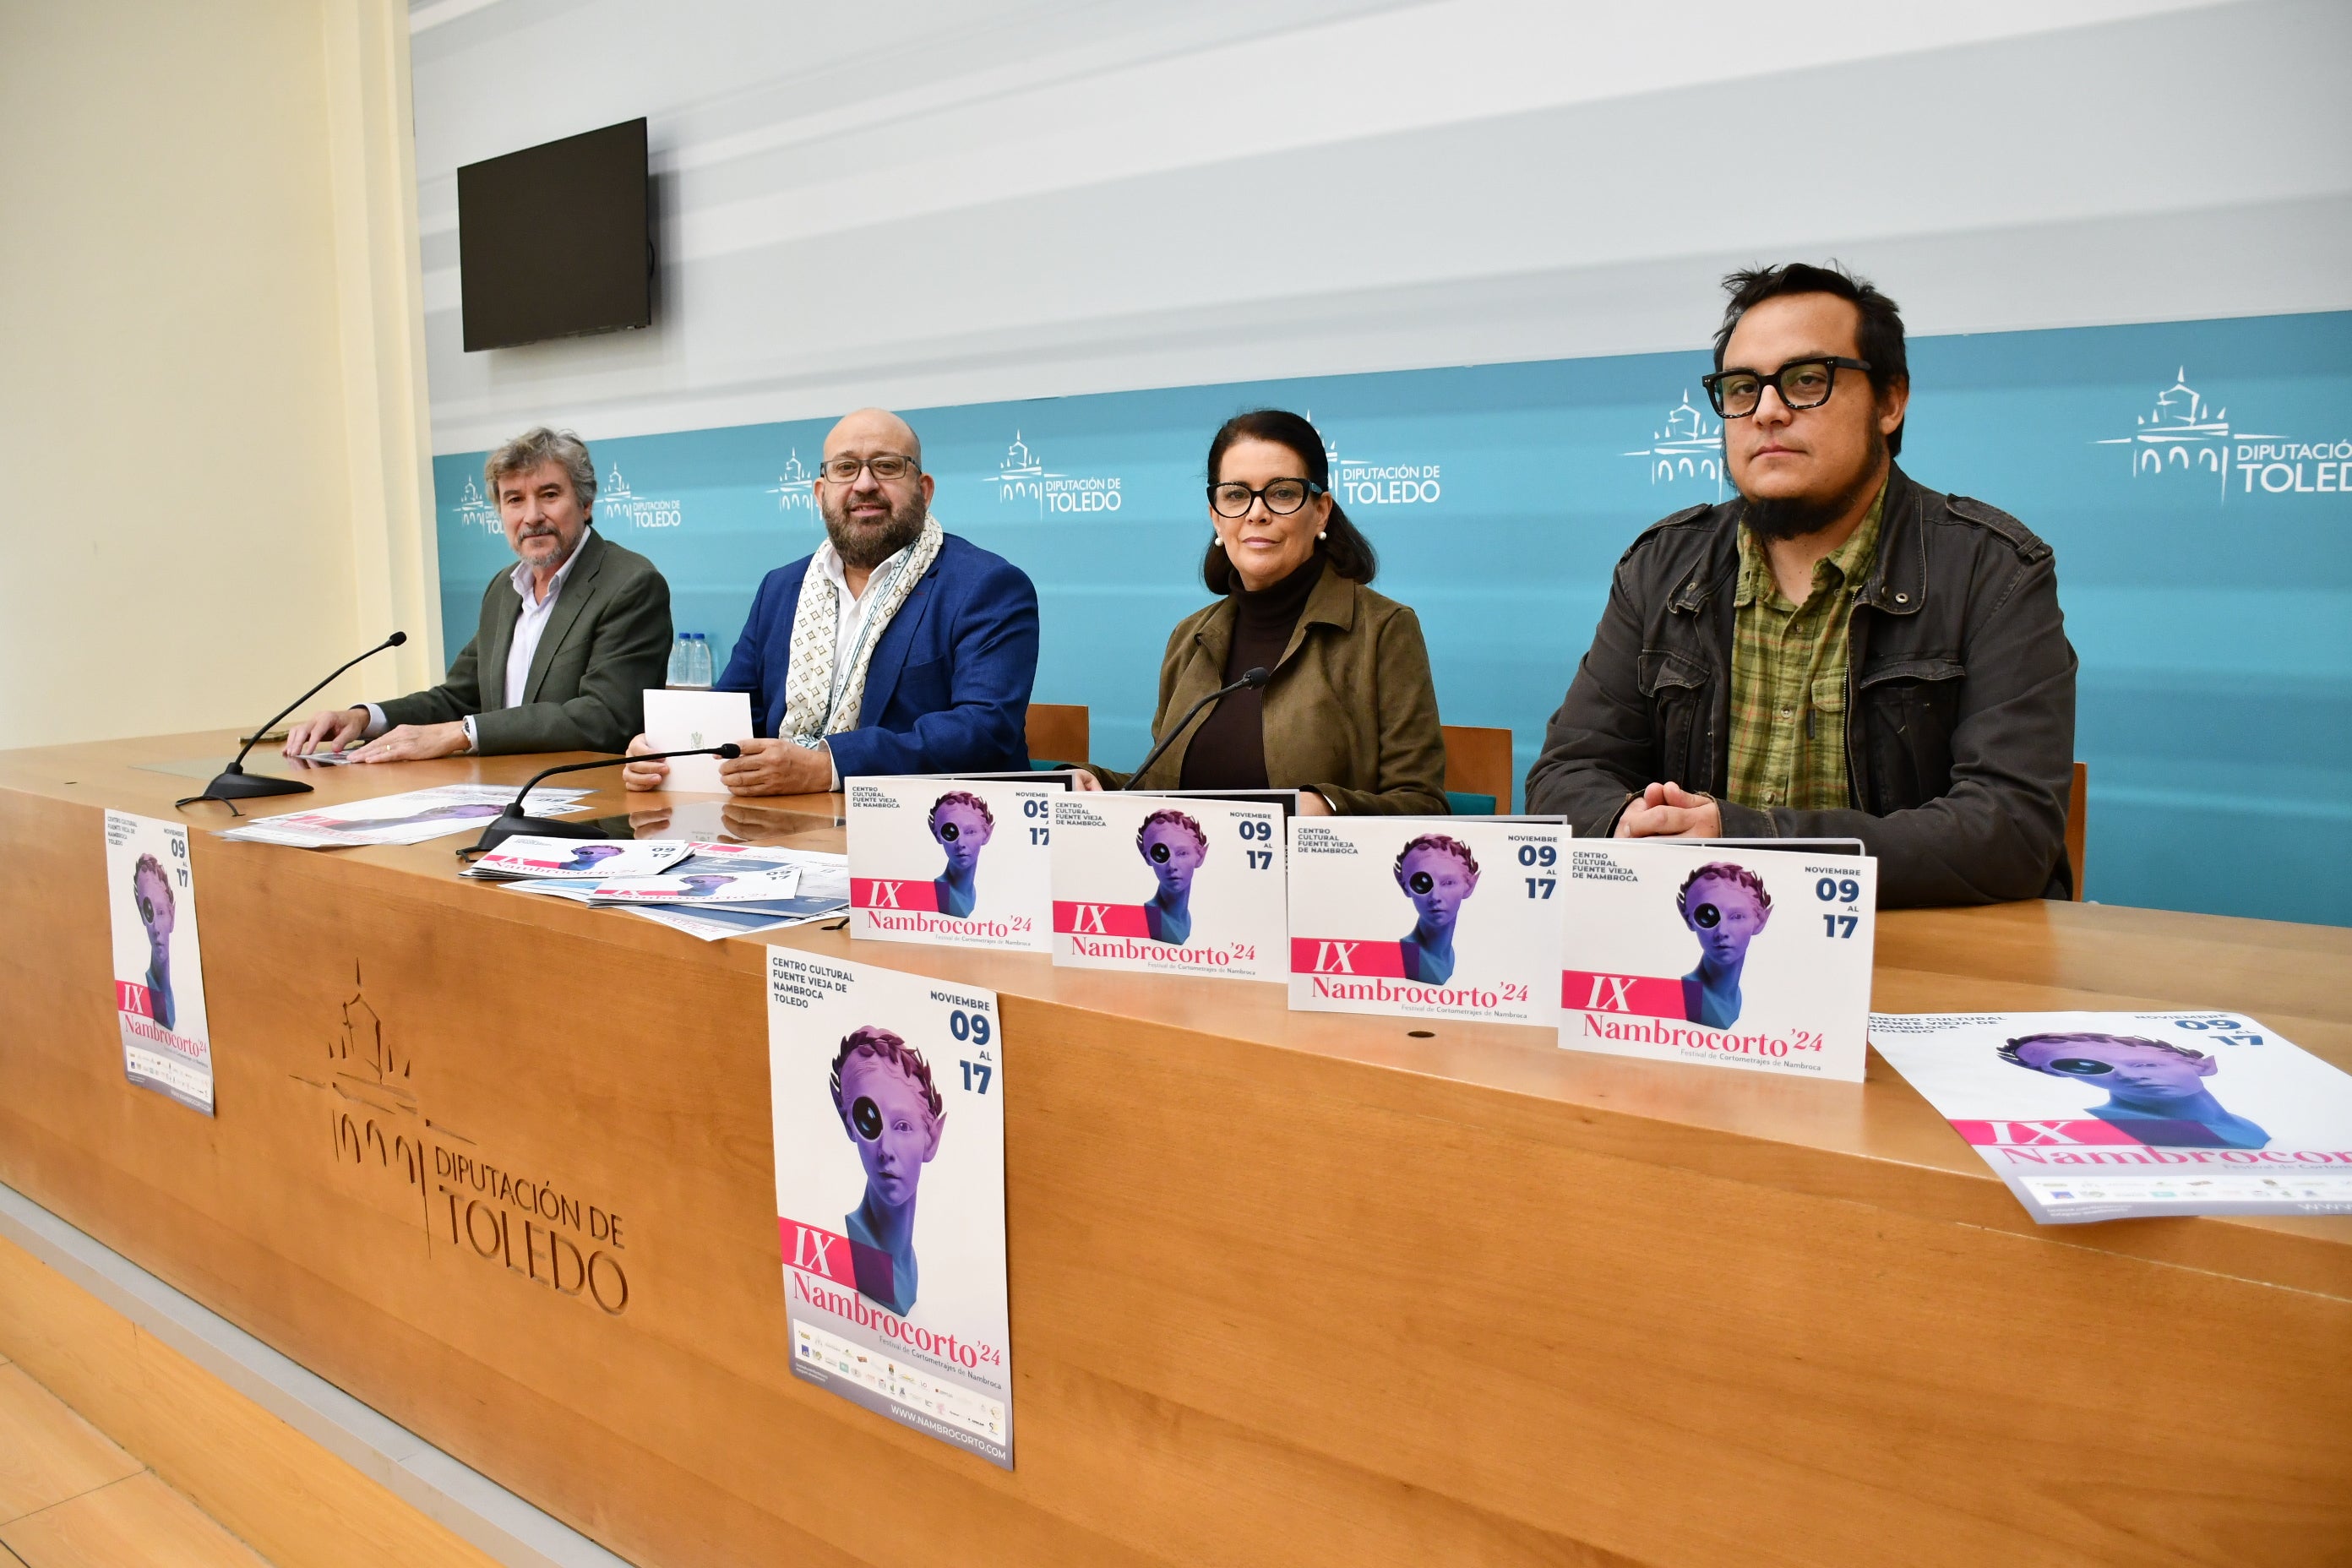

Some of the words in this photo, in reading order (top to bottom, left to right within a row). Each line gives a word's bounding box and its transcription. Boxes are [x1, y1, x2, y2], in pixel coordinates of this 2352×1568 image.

[1342, 463, 1419, 481] DIPUTACIÓN
[1424, 466, 1440, 478] DE
[1046, 476, 1105, 492] DIPUTACIÓN
[1108, 478, 1121, 489] DE
[1343, 480, 1440, 504] TOLEDO
[1046, 491, 1121, 512] TOLEDO
[486, 519, 504, 534] TOL
[634, 510, 681, 527] TOLEDO
[1029, 827, 1049, 846] 17
[1239, 820, 1271, 841] 09
[172, 838, 185, 858] 09
[1246, 850, 1272, 869] 17
[1517, 844, 1557, 867] 09
[1572, 858, 1618, 867] CULTURAL
[1805, 867, 1861, 876] NOVIEMBRE
[177, 868, 188, 887] 17
[1525, 878, 1556, 900] 17
[1587, 874, 1638, 882] NAMBROCA
[868, 880, 904, 908] IX
[1816, 877, 1859, 903] 09
[868, 910, 1008, 938] Nambrocorto
[1071, 904, 1111, 934] IX
[1823, 914, 1859, 939] 17
[1071, 936, 1229, 966] Nambrocorto
[1313, 941, 1360, 973] IX
[772, 957, 807, 972] CENTRO
[809, 965, 854, 982] CULTURAL
[773, 969, 806, 984] FUENTE
[808, 977, 832, 989] VIEJA
[835, 983, 847, 993] DE
[123, 983, 144, 1014] IX
[773, 981, 824, 1000] NAMBROCA
[774, 994, 808, 1009] TOLEDO
[930, 990, 990, 1011] NOVIEMBRE
[1312, 976, 1497, 1008] Nambrocorto
[1584, 975, 1637, 1012] IX
[1436, 1006, 1482, 1016] Cortometrajes
[1494, 1010, 1527, 1019] Nambroca
[125, 1014, 199, 1057] Nambrocorto
[950, 1010, 991, 1045] 09
[1582, 1014, 1788, 1058] Nambrocorto
[2174, 1019, 2241, 1030] 09
[2207, 1035, 2263, 1046] 17
[978, 1050, 992, 1061] AL
[1680, 1048, 1707, 1059] Festival
[1708, 1051, 1717, 1059] de
[1719, 1054, 1770, 1067] Cortometrajes
[1772, 1058, 1782, 1067] de
[1783, 1060, 1821, 1071] Nambroca
[959, 1059, 992, 1095] 17
[1985, 1121, 2085, 1145] IX
[1998, 1146, 2352, 1164] Nambrocor
[436, 1146, 580, 1232] DIPUTACIÓN
[590, 1206, 625, 1250] DE
[438, 1184, 629, 1315] TOLEDO
[792, 1225, 836, 1277] IX
[792, 1271, 977, 1369] Nambrocorto
[879, 1336, 901, 1350] Festival
[902, 1345, 910, 1353] de
[912, 1349, 956, 1373] Cortometrajes
[958, 1367, 966, 1376] de
[967, 1371, 1002, 1390] Nambroca
[890, 1404, 1006, 1460] WWW.NAMBROCORTO.COM
